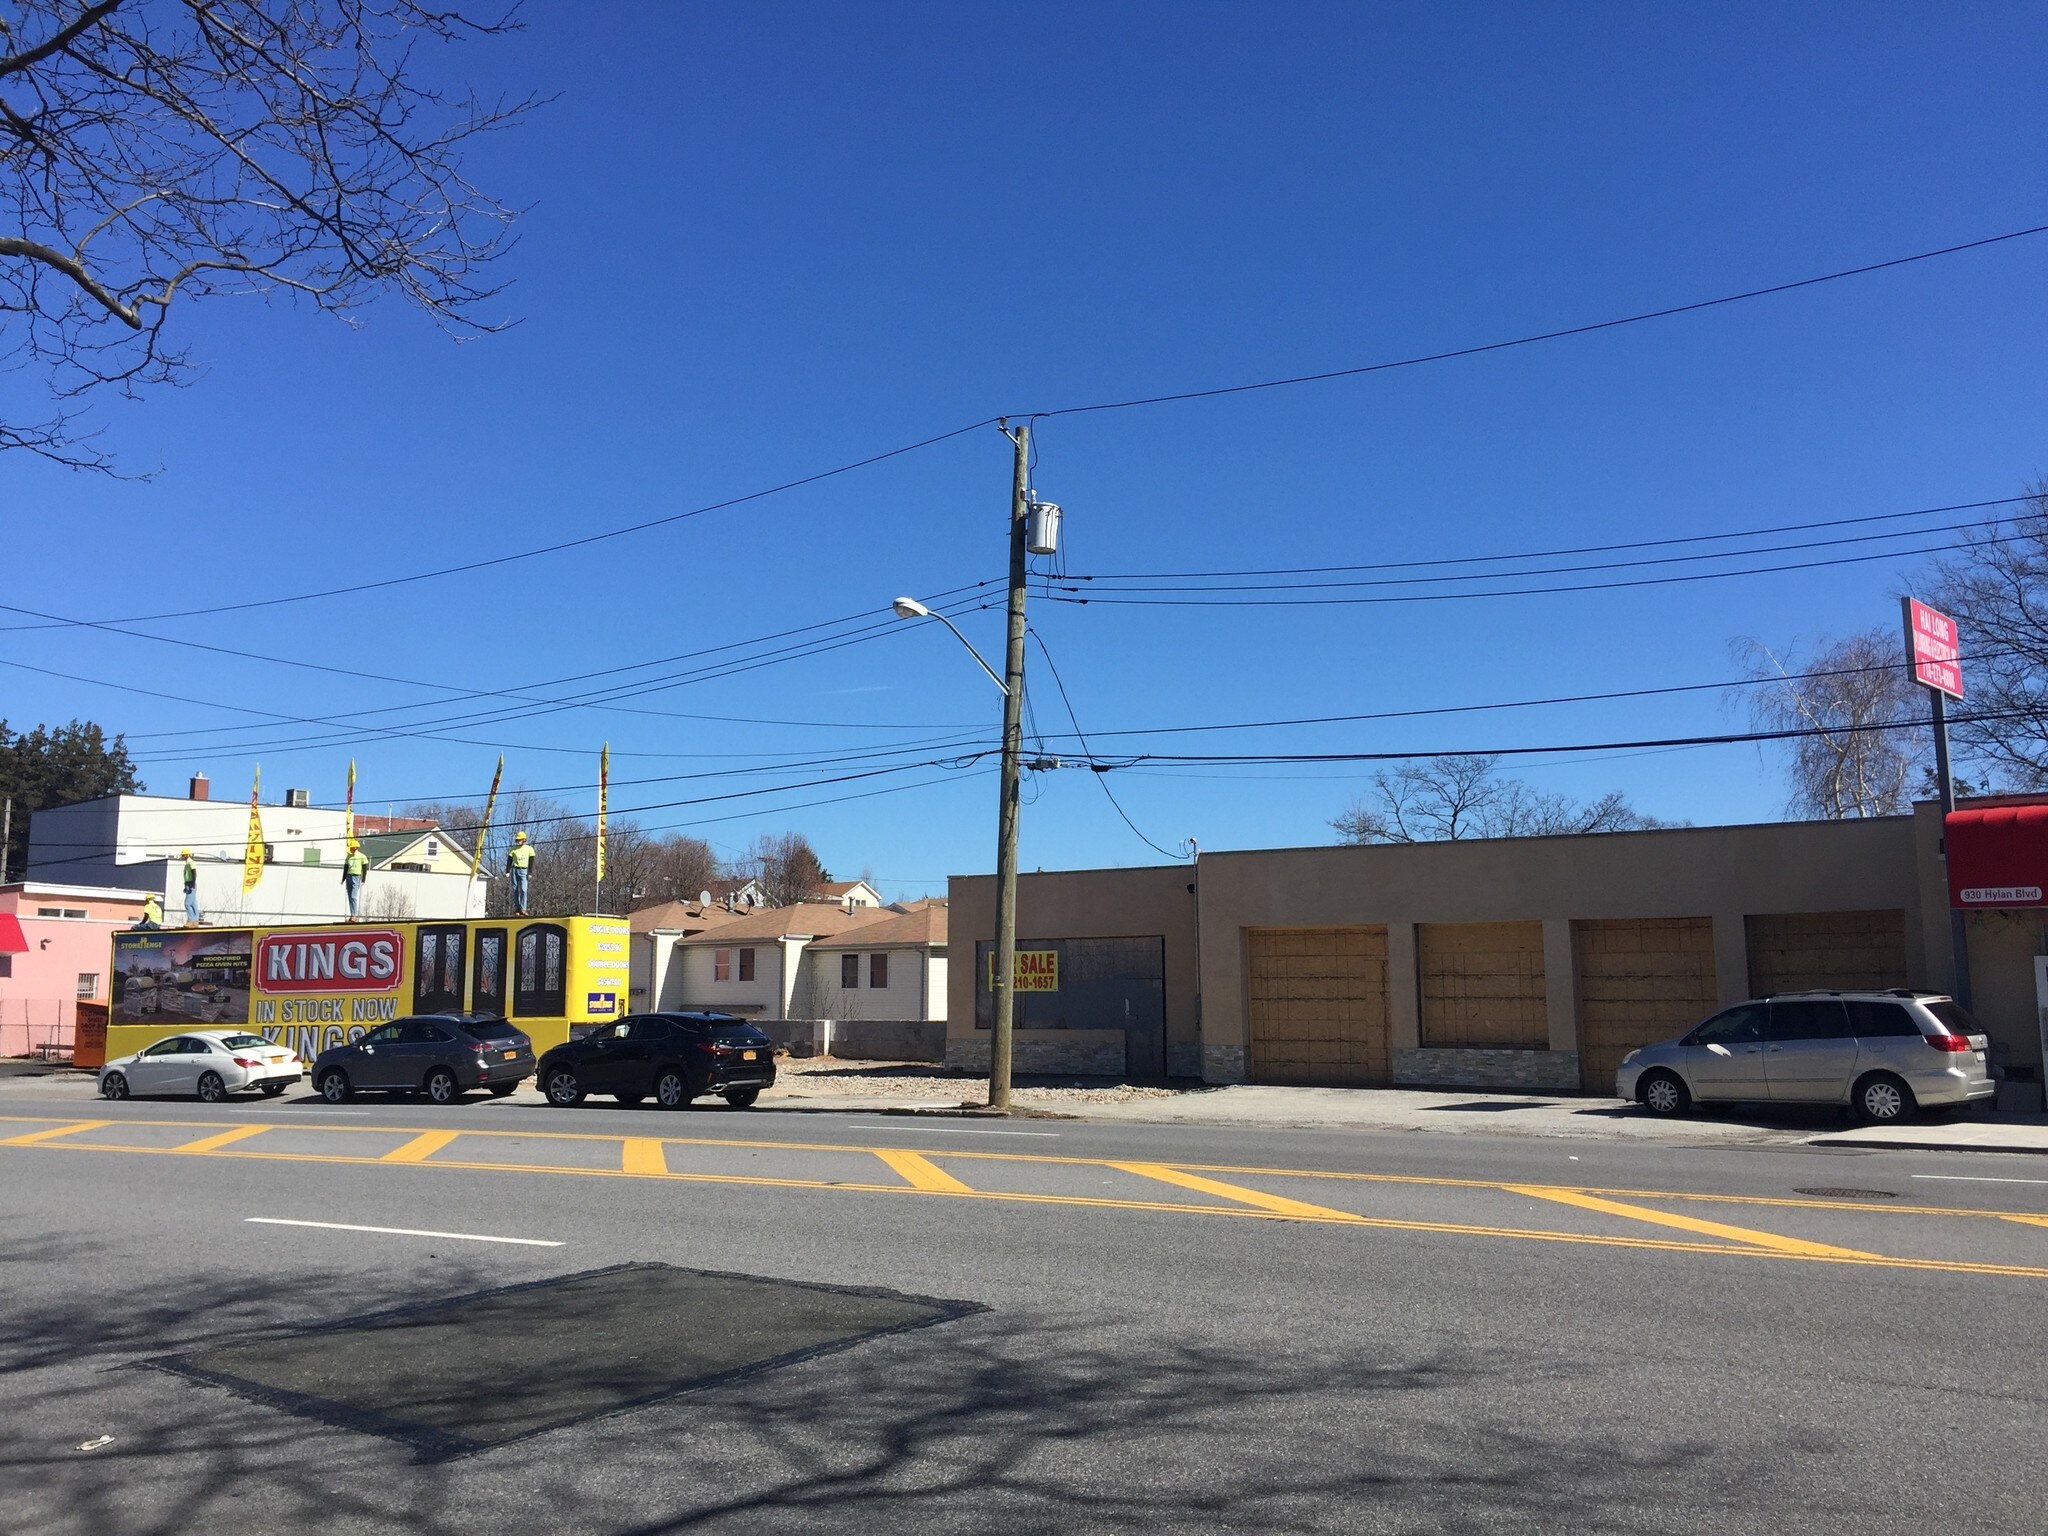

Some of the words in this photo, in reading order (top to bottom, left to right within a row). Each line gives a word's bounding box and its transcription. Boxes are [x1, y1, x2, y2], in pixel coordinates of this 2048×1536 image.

[1964, 890, 1981, 900] 930
[1984, 889, 2013, 900] Hylan
[2015, 888, 2038, 898] Blvd
[267, 941, 396, 980] KINGS
[1020, 953, 1055, 974] SALE
[256, 1000, 276, 1023] IN
[281, 997, 345, 1022] STOCK
[351, 996, 399, 1021] NOW
